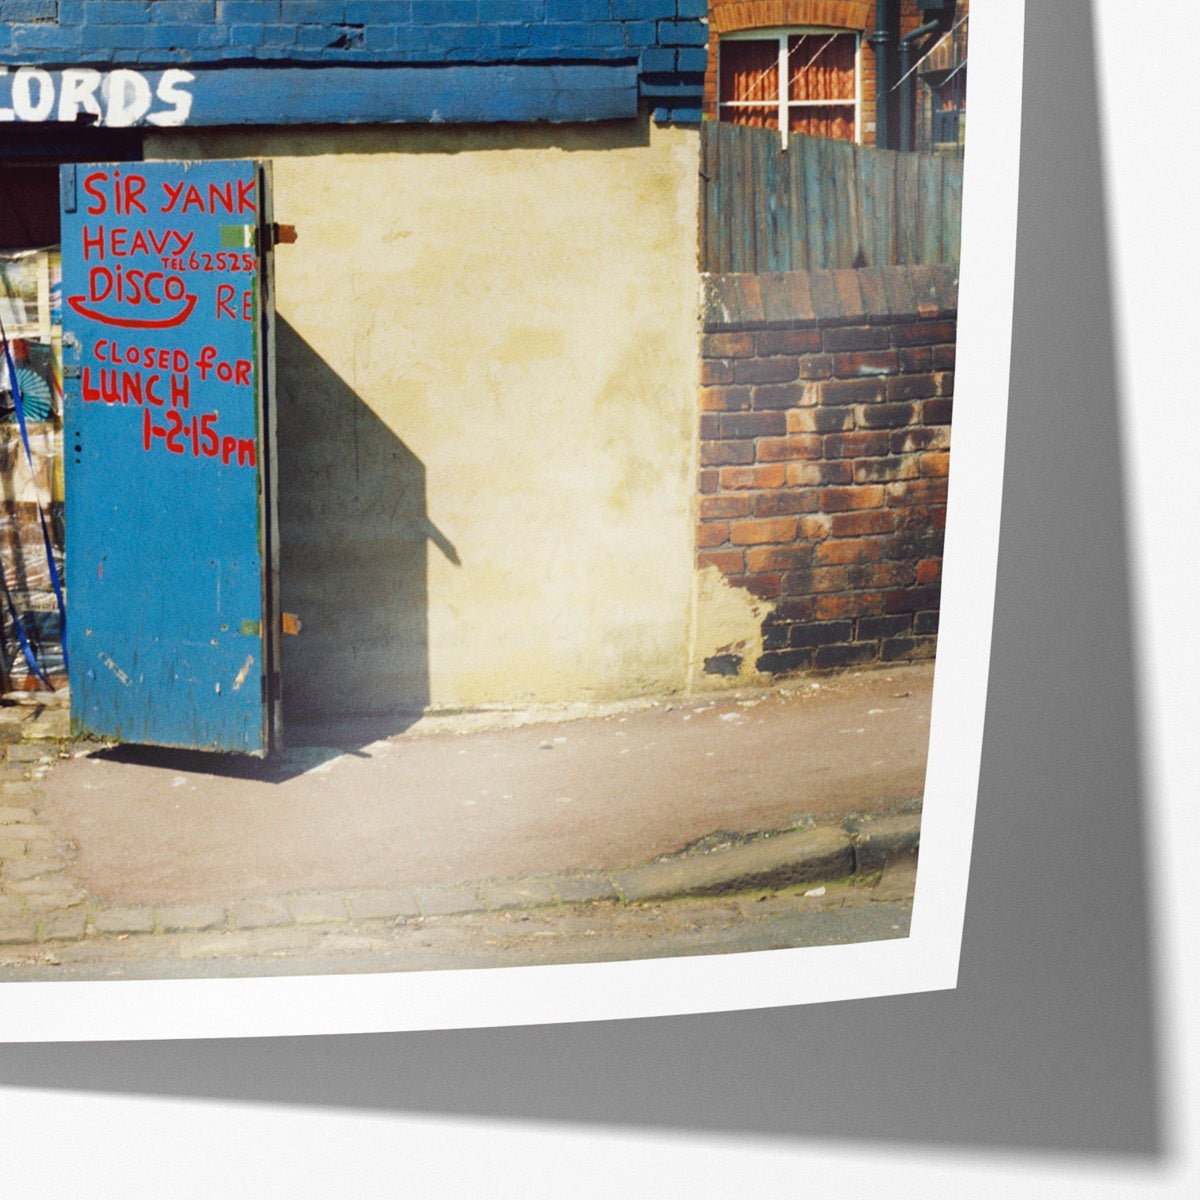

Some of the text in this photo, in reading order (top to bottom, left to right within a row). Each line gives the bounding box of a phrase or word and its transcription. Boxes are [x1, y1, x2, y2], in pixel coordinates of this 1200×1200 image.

[83, 224, 194, 261] HEAVY
[160, 257, 186, 272] TEL
[94, 339, 189, 373] CLOSED
[81, 366, 190, 409] LUNCH
